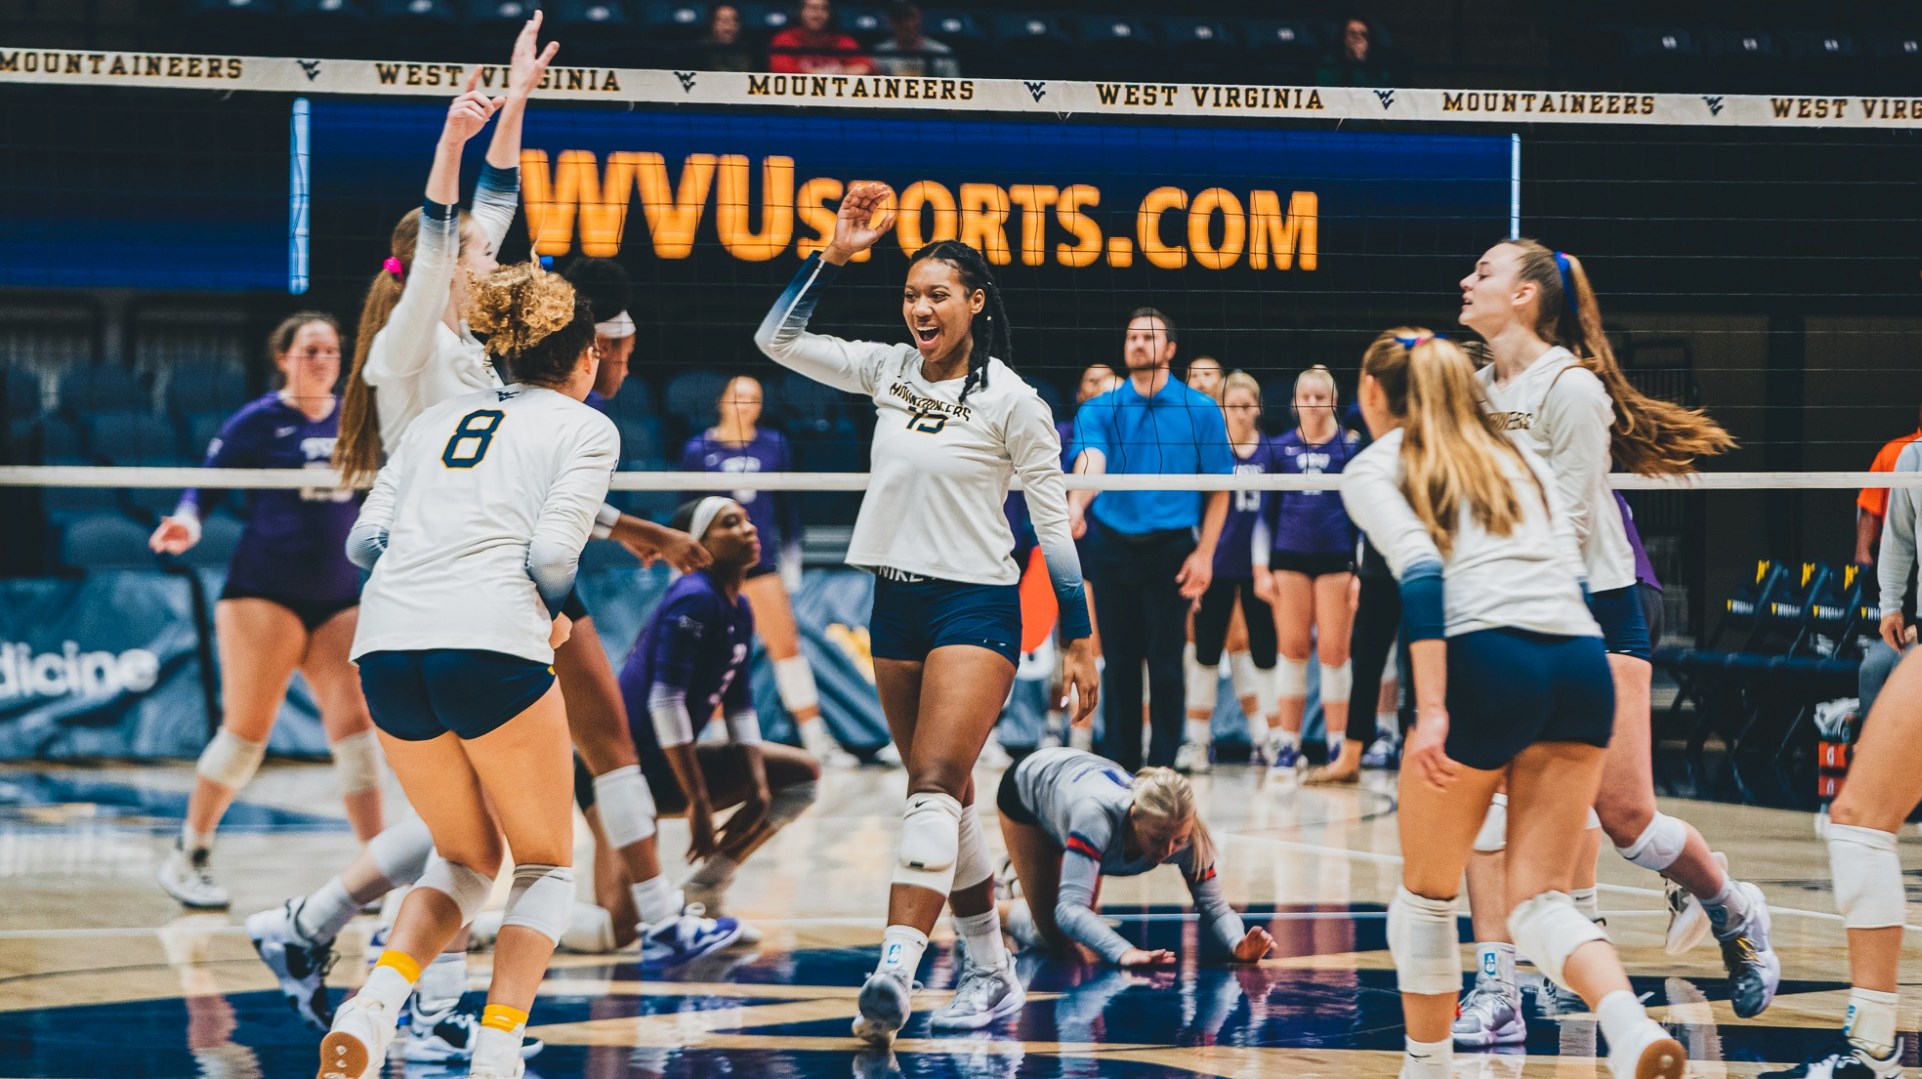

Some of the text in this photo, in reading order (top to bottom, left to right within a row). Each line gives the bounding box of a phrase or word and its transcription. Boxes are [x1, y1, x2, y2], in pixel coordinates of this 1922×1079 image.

[0, 51, 243, 80] MOUNTAINEERS
[375, 63, 463, 87] WEST
[482, 66, 621, 92] VIGINIA
[748, 74, 974, 101] MOUNTAINEERS
[1096, 83, 1178, 107] WEST
[1191, 86, 1325, 110] VIRGINIA
[1442, 92, 1656, 115] MOUNTAINEERS
[1770, 97, 1848, 119] WEST
[440, 408, 507, 471] 8
